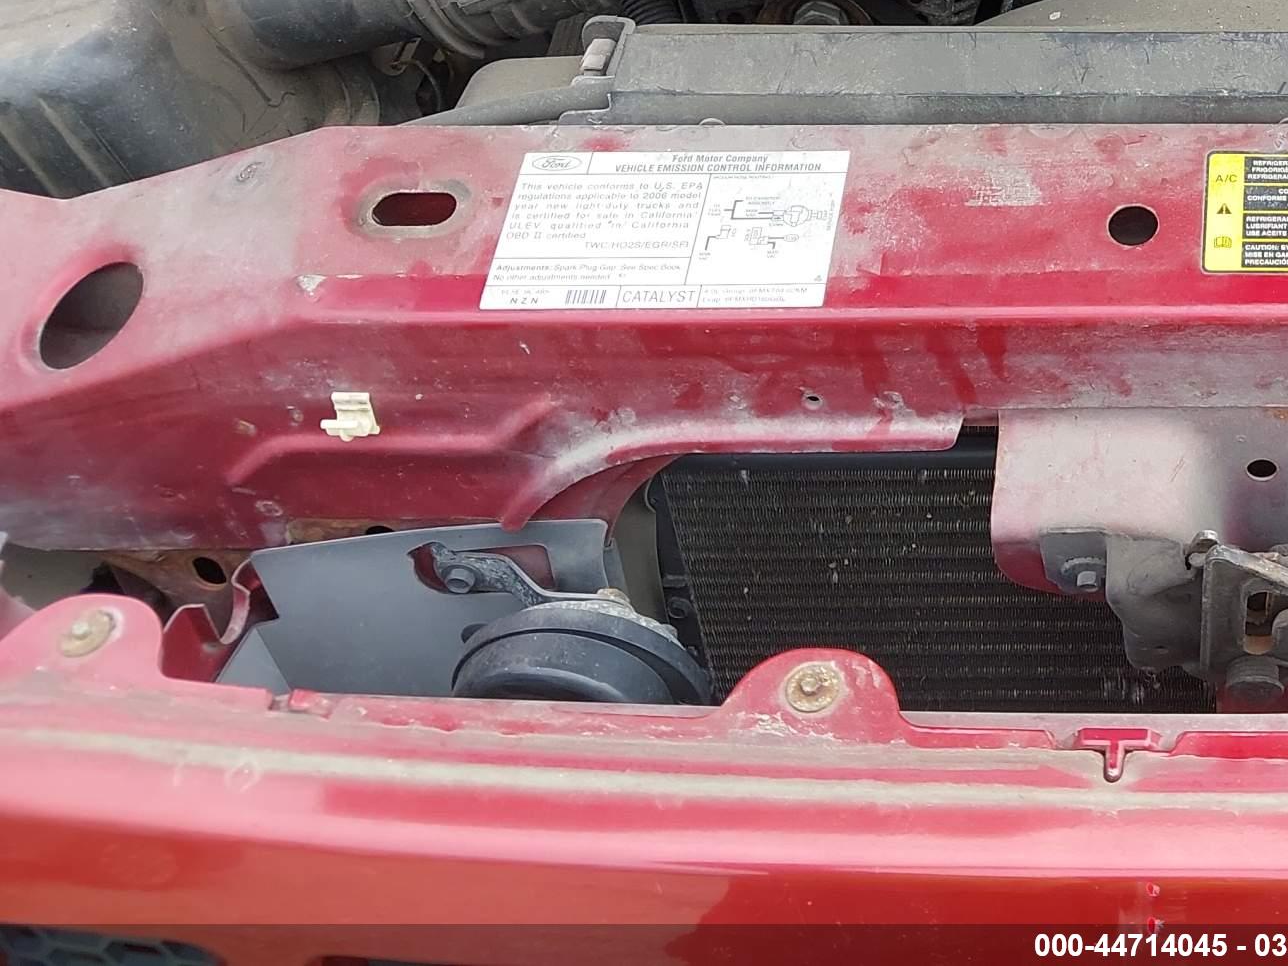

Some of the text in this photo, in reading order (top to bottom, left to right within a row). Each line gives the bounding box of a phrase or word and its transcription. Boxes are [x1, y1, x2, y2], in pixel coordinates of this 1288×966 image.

[672, 154, 768, 165] Ford Motor Company
[615, 163, 821, 172] VEHICLE EMISSION CONTROL INFORMATION
[1215, 174, 1238, 183] A/C
[681, 182, 703, 190] EPA
[622, 290, 696, 303] CATALYST
